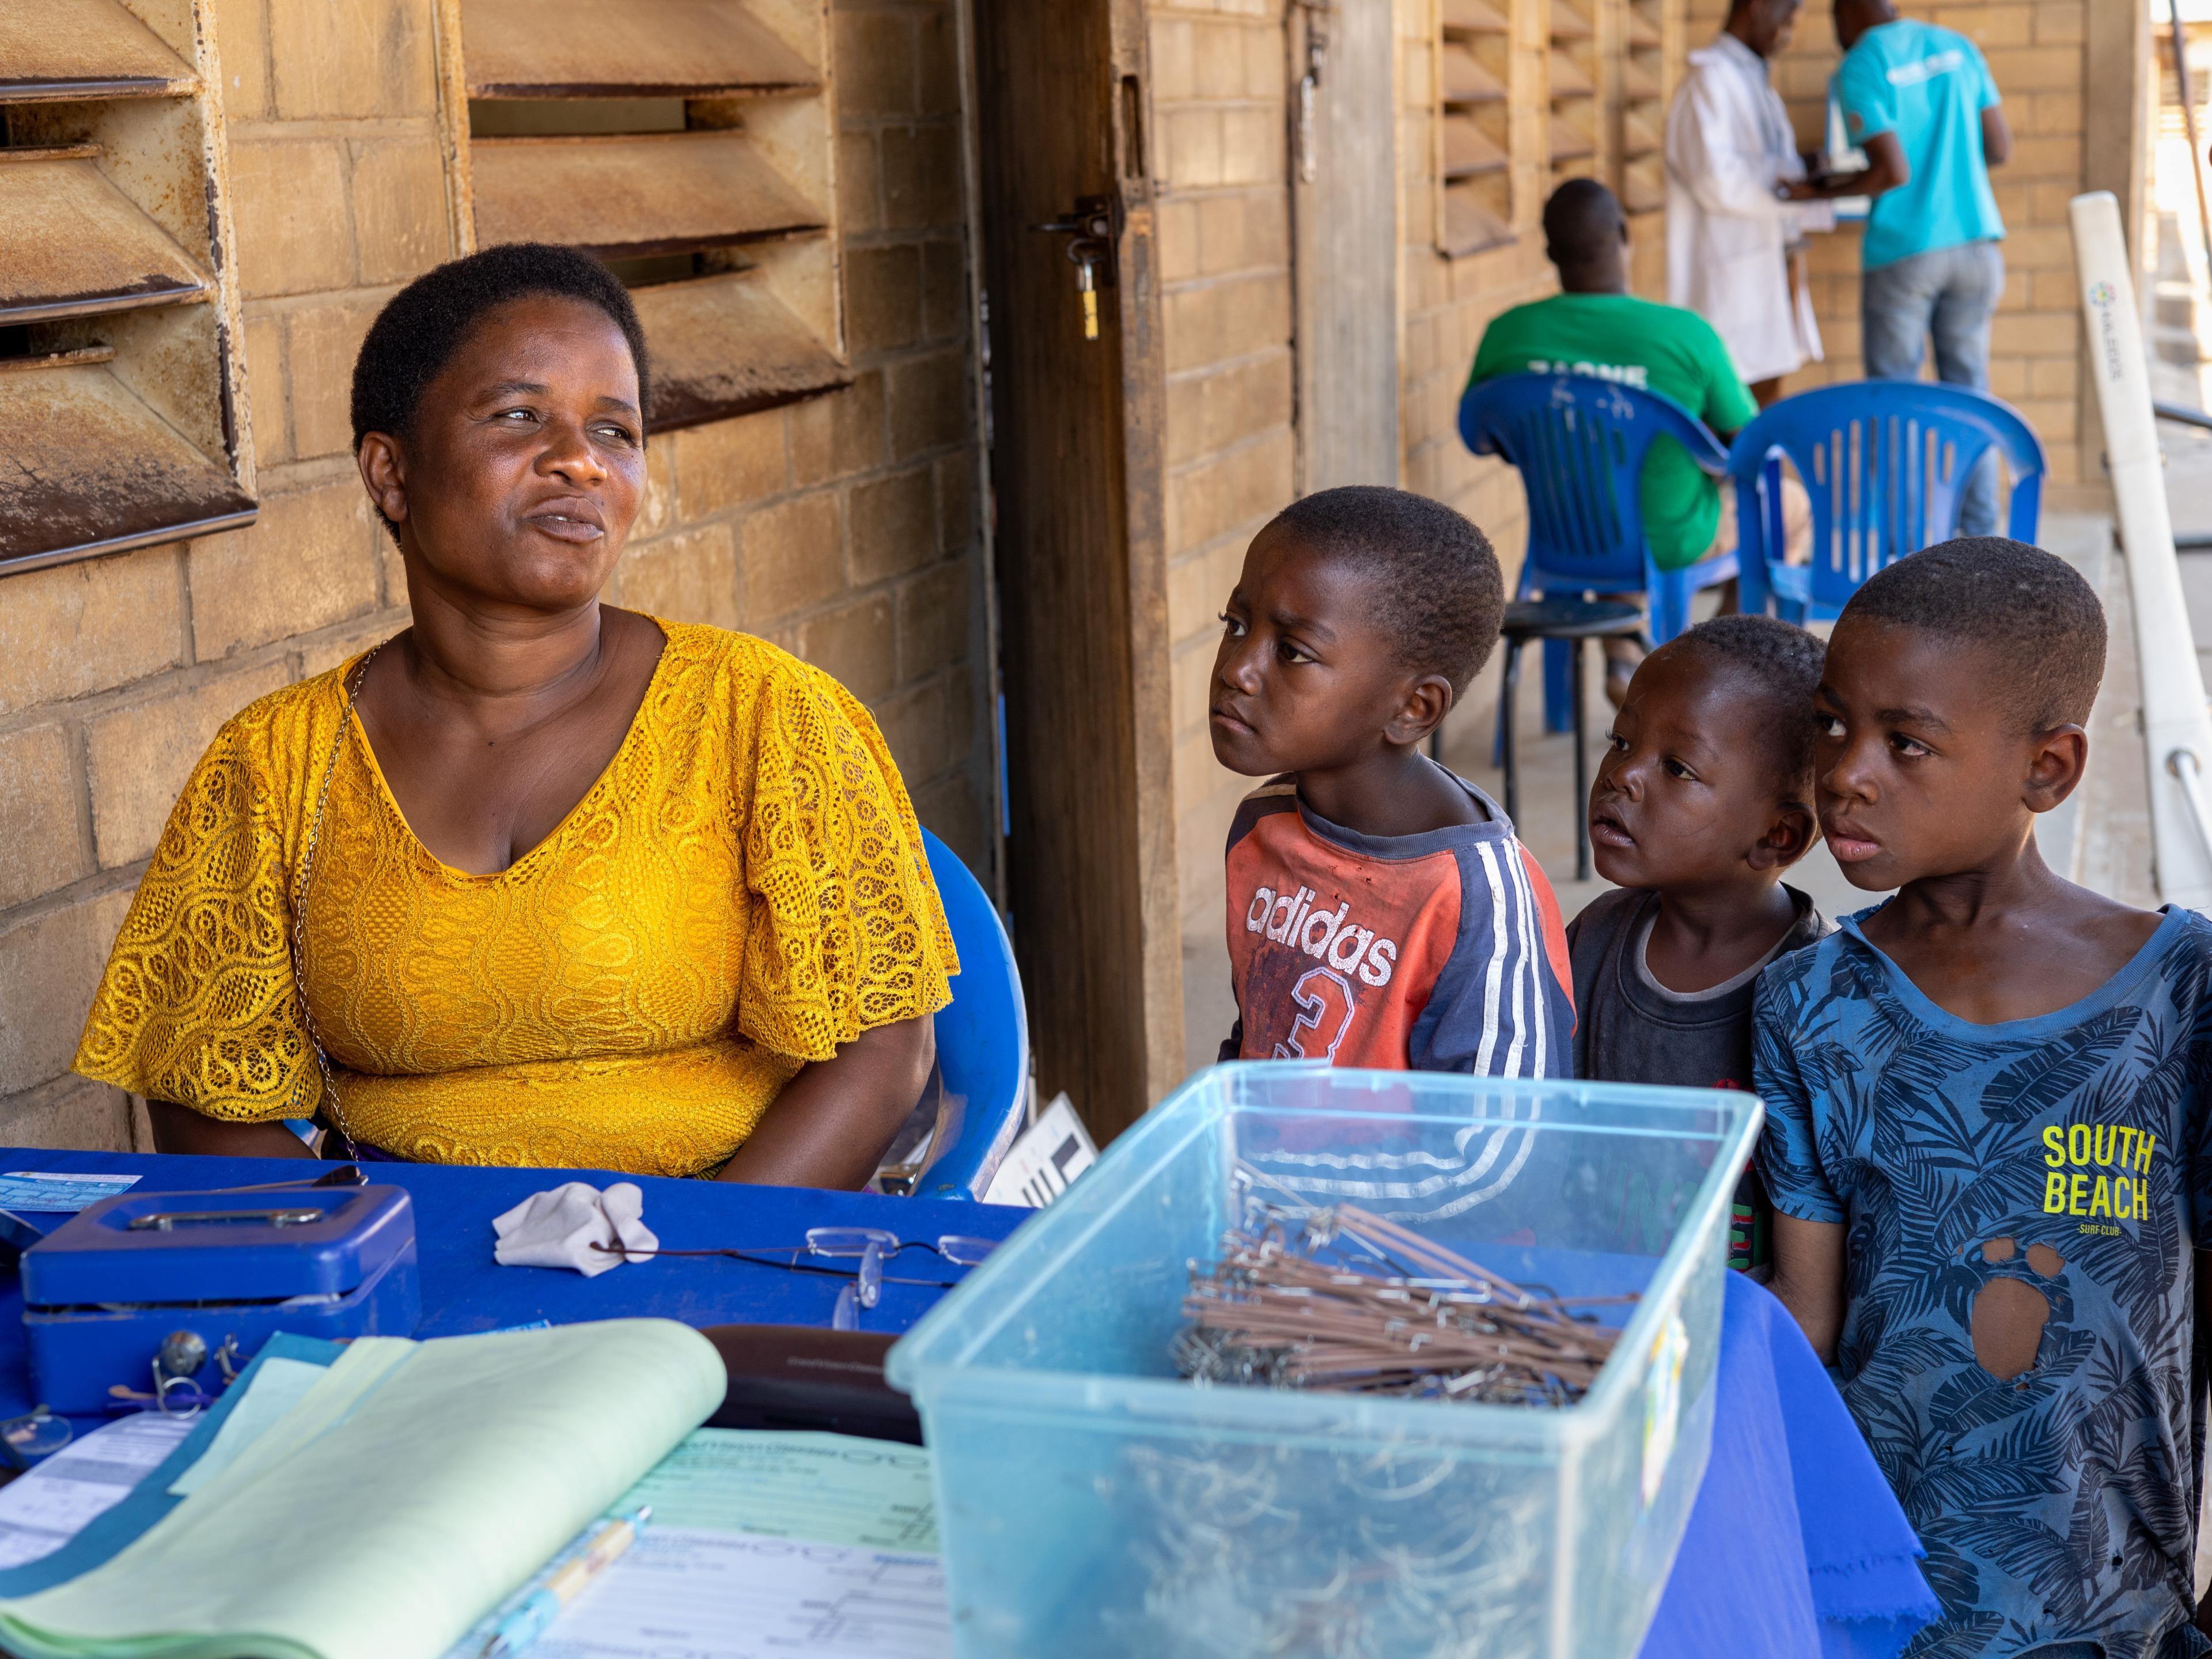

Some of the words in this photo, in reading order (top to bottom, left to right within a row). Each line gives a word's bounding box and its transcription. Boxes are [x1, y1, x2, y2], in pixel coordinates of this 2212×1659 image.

[1247, 885, 1397, 987] adidas
[1271, 965, 1355, 1066] 3
[2042, 1123, 2156, 1175] SOUTH
[2043, 1171, 2149, 1221] BEACH
